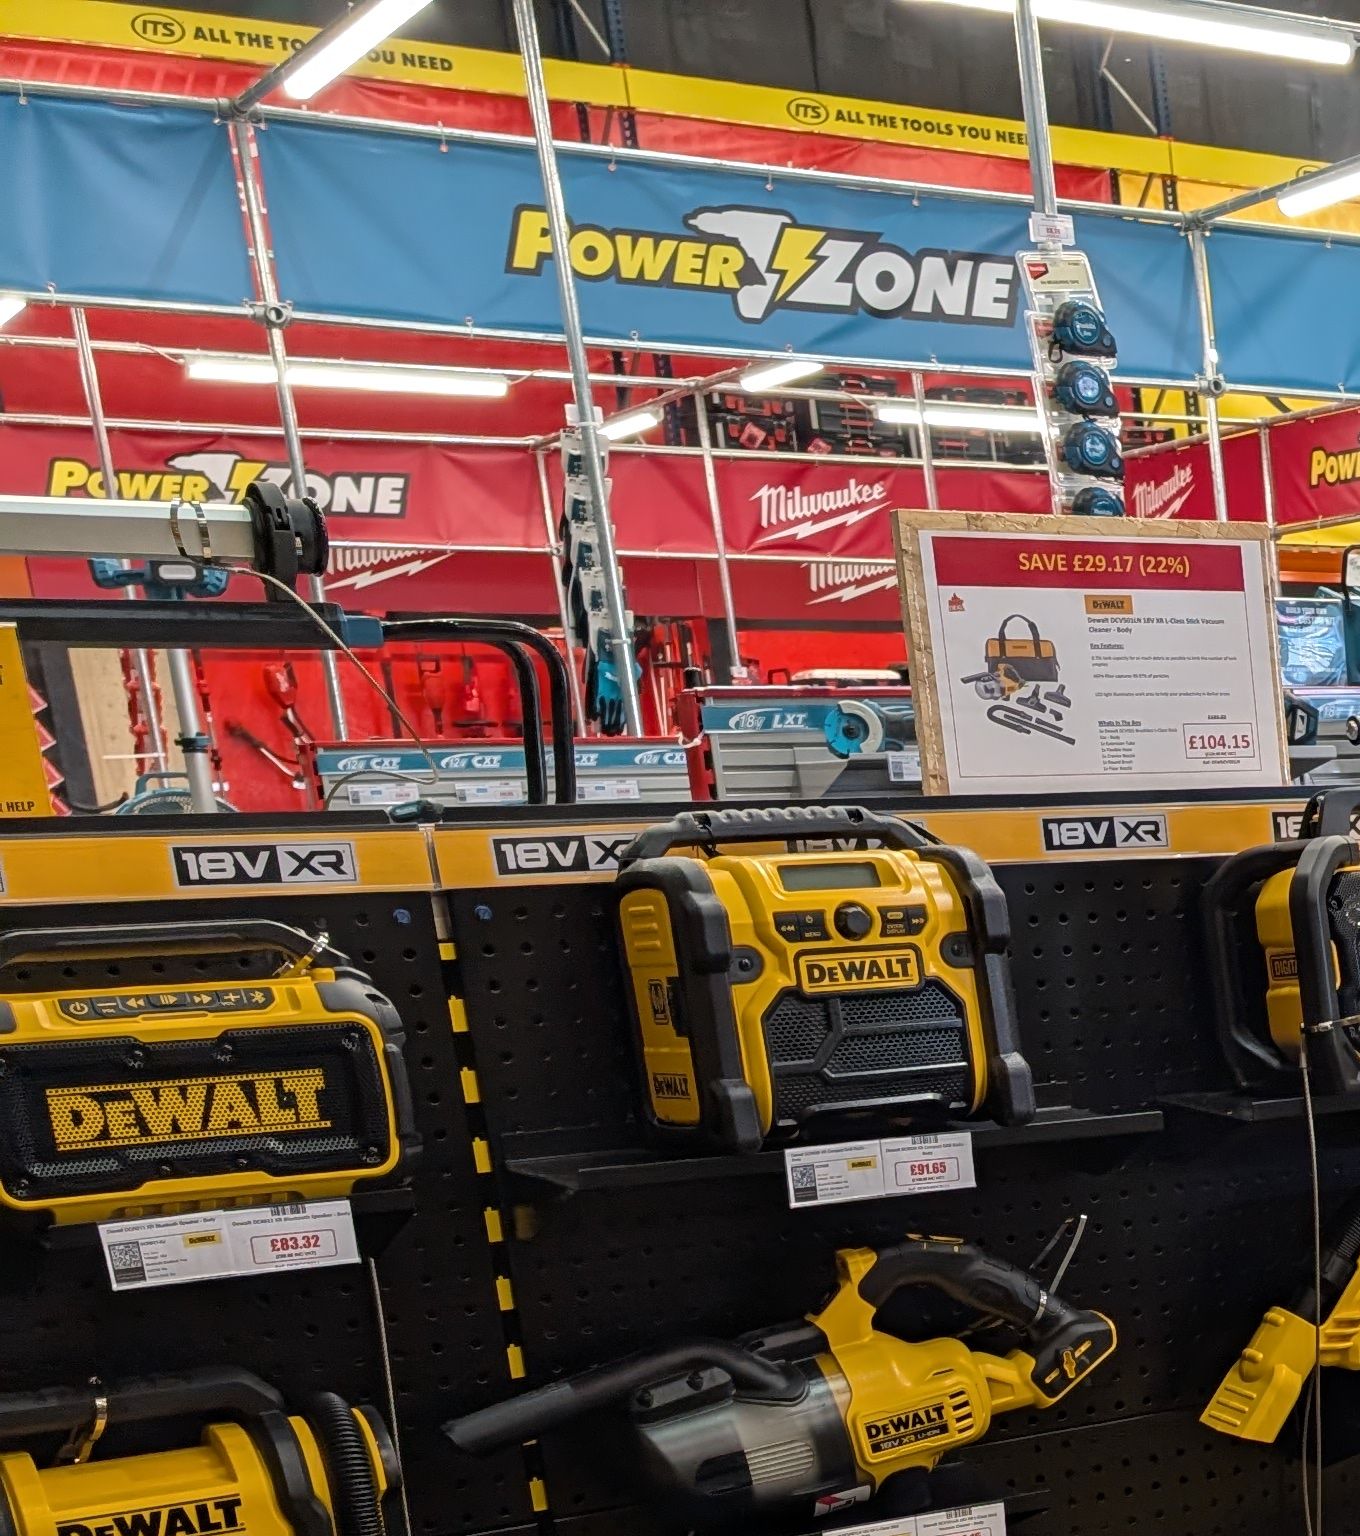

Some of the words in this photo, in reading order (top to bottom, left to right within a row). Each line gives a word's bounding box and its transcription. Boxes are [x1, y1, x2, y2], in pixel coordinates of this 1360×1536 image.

[194, 26, 231, 44] ALL
[238, 32, 274, 50] THE
[401, 53, 454, 72] NEED
[835, 109, 865, 125] ALL
[867, 113, 898, 129] THE
[902, 118, 954, 136] TOOLS
[958, 125, 992, 140] YOU
[512, 208, 745, 290] POWER
[803, 225, 1015, 320] ZONE
[750, 480, 887, 530] Milwaukee
[1019, 552, 1068, 572] SAVE
[1073, 554, 1134, 574] £29.17
[1139, 555, 1191, 578] (22%)
[1188, 734, 1251, 751] £104.15
[6, 801, 36, 813] HELP
[1047, 819, 1112, 848] 18V
[179, 849, 273, 882] 18V
[500, 840, 578, 872] 18V
[909, 1161, 947, 1176] £91.65
[270, 1234, 322, 1252] £83.32
